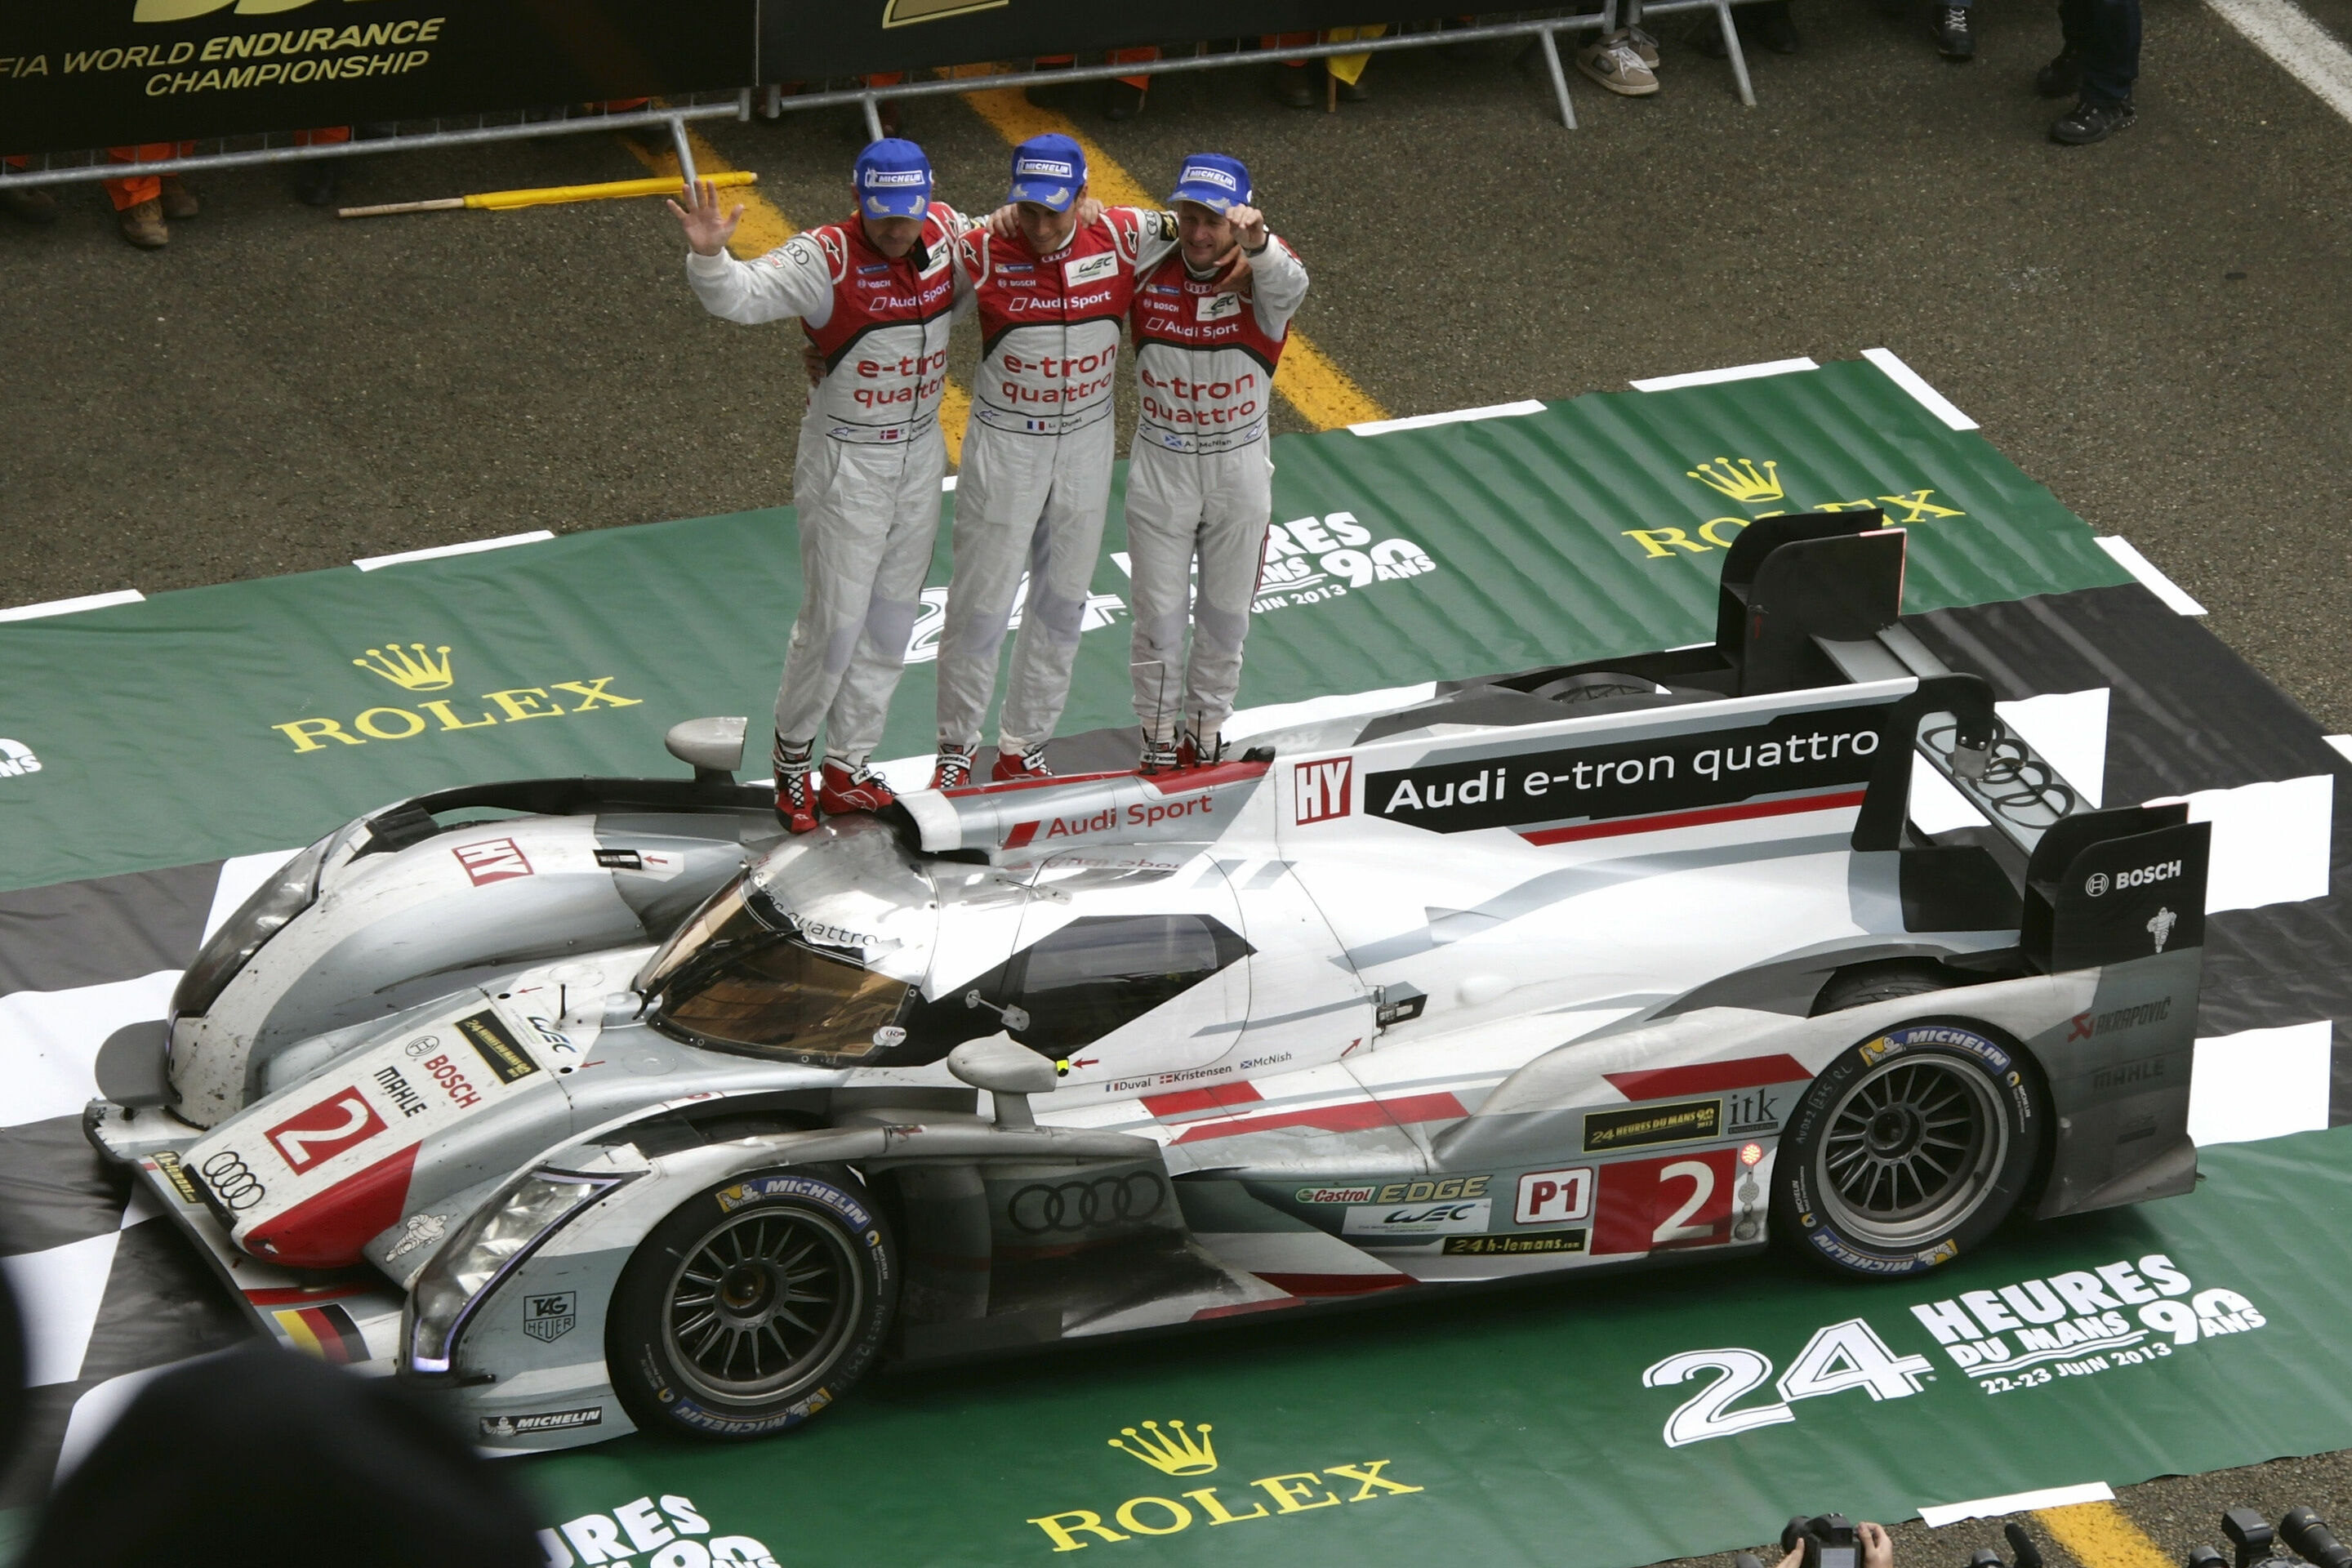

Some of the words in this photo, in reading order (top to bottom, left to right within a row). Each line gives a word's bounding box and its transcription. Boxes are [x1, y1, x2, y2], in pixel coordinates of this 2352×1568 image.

[0, 54, 48, 78] FIA
[63, 41, 195, 74] WORLD
[199, 17, 446, 62] ENDURANCE
[145, 50, 430, 97] CHAMPIONSHIP
[878, 172, 922, 183] MICHELIN
[1025, 163, 1069, 176] MICHELIN
[1190, 170, 1233, 186] MICHELIN
[1079, 256, 1114, 274] WEC
[889, 296, 923, 308] Audi
[923, 281, 951, 303] Sport
[1010, 279, 1036, 287] BOSCH
[1029, 297, 1068, 310] Audi
[1071, 291, 1111, 310] Sport
[1153, 301, 1179, 313] BOSCH
[1165, 321, 1199, 337] Audi
[857, 349, 948, 379] e-tro
[1004, 344, 1117, 379] e-tron
[853, 375, 946, 408] quattr
[1002, 372, 1112, 404] quattro
[1142, 369, 1254, 402] e-tron
[1143, 396, 1256, 425] quattro
[1374, 554, 1437, 582] ANS
[1291, 583, 1348, 606] 2013
[271, 675, 644, 754] ROLEX
[1385, 768, 1507, 813] Audi
[1523, 754, 1676, 797] e-tron
[1693, 730, 1880, 782] quattro
[1297, 762, 1350, 822] HY
[1045, 808, 1117, 840] Audi
[1127, 795, 1214, 826] Sport
[456, 840, 530, 879] HY
[2116, 860, 2182, 890] BOSCH
[526, 1016, 577, 1054] WEC
[1905, 1028, 2007, 1068] MICHELIN
[423, 1054, 483, 1110] BOSCH
[1119, 1077, 1152, 1092] Duval
[1174, 1063, 1232, 1083] Kristensen
[1252, 1051, 1293, 1068] McNish
[2093, 1059, 2164, 1089] MAHLE
[373, 1065, 429, 1119] MAHLE
[1729, 1087, 1780, 1125] itk
[274, 1097, 370, 1167] 2
[1590, 1129, 1615, 1144] 24
[1616, 1120, 1652, 1137] HEURES
[1652, 1116, 1668, 1129] DU
[1668, 1112, 1696, 1126] MANS
[764, 1179, 869, 1226] MICHELIN
[1313, 1188, 1373, 1203] Castrol
[1377, 1175, 1494, 1203] EDGE
[1529, 1178, 1580, 1216] P1
[1652, 1160, 1716, 1244] 2
[1383, 1203, 1477, 1224] WEC
[1813, 1232, 1915, 1273] MICHELIN
[532, 1295, 568, 1316] TAG
[2137, 1288, 2255, 1346] 90
[527, 1317, 572, 1339] HEUER
[2198, 1307, 2267, 1339] ANS
[1642, 1316, 1935, 1449] 24
[1912, 1254, 2193, 1345] HEURES
[1944, 1336, 2011, 1369] DU
[2014, 1311, 2131, 1352] MANS
[1980, 1367, 2052, 1396] 22-23
[2055, 1356, 2111, 1378] JUIN
[2111, 1342, 2172, 1367] 2013
[516, 1410, 600, 1429] MICHELIN
[675, 1405, 787, 1433] MICHELIN
[1026, 1459, 1425, 1553] ROLEX
